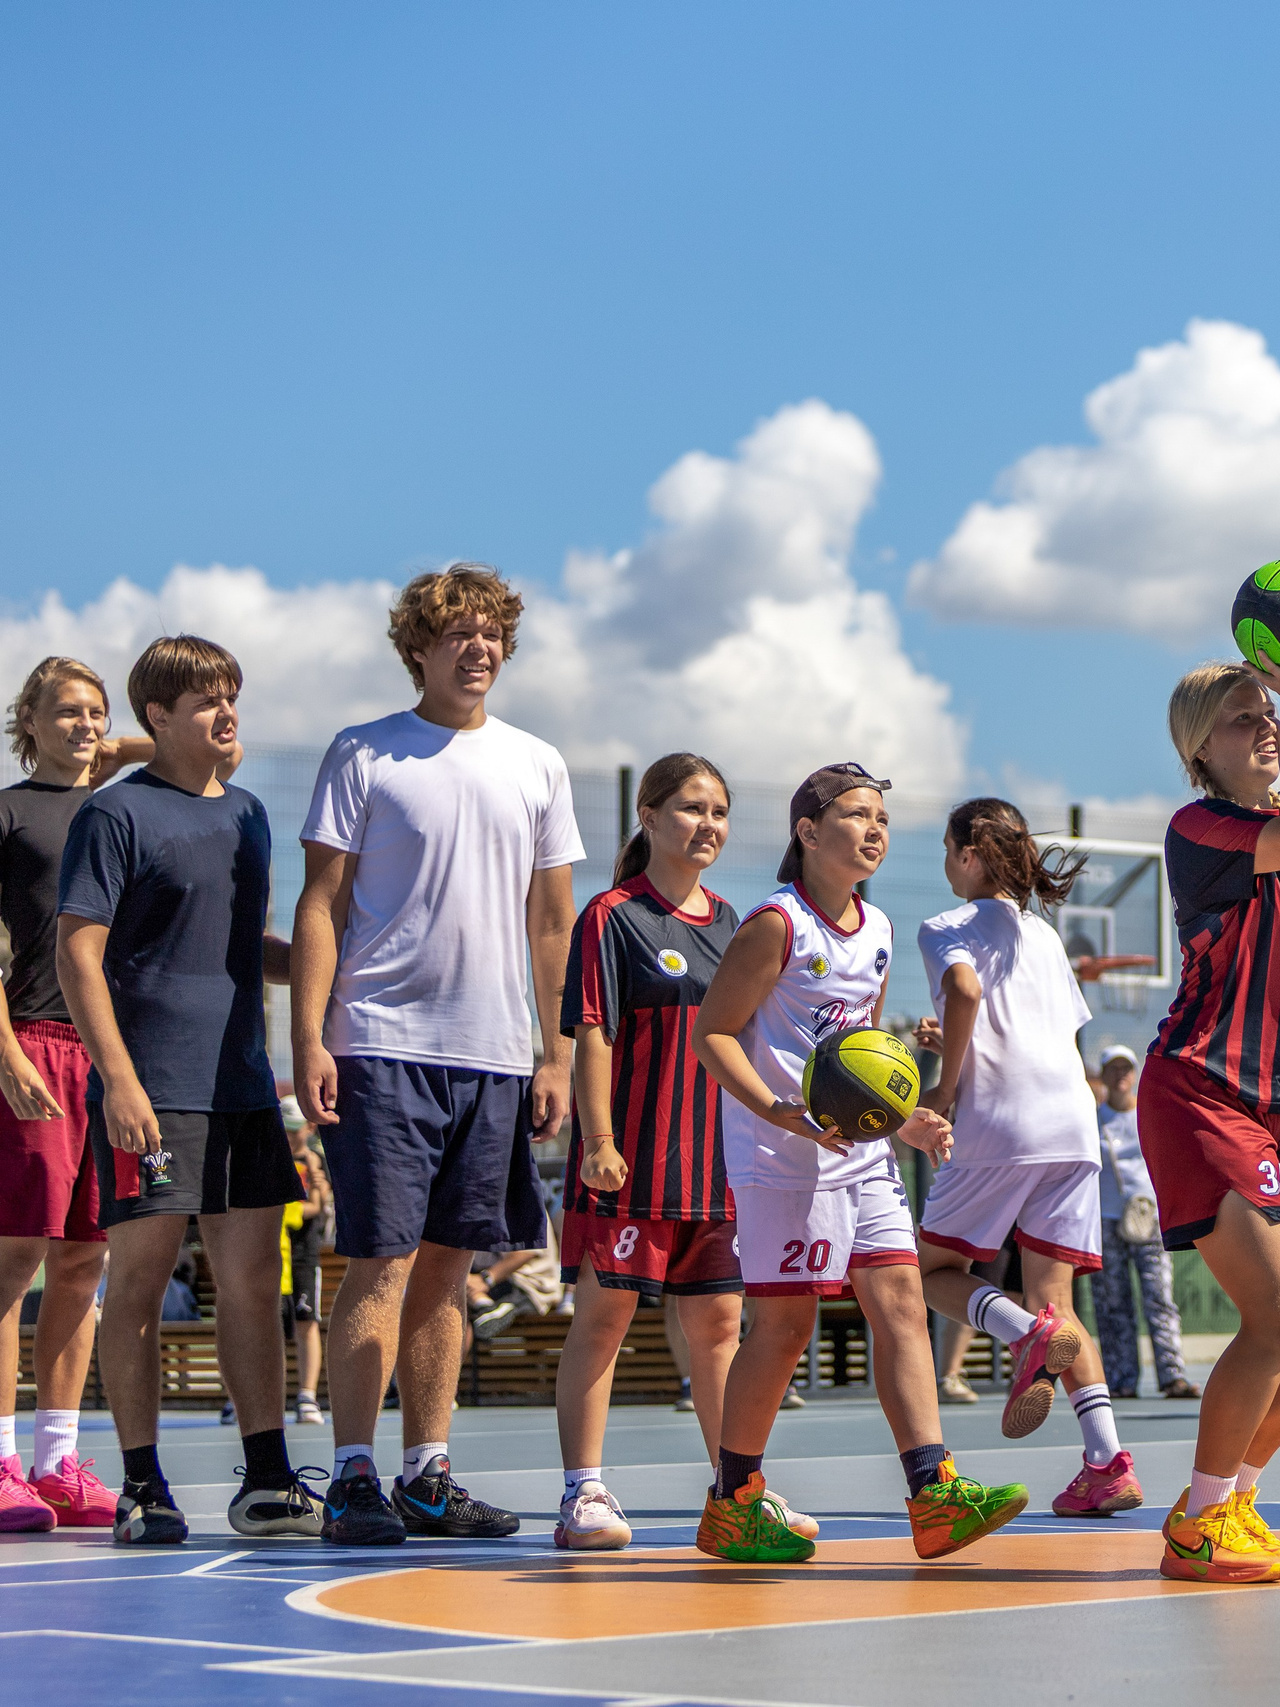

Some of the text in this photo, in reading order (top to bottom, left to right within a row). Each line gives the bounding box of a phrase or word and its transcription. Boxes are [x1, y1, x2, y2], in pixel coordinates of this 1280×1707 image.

[864, 1113, 882, 1129] РФБ
[613, 1225, 640, 1261] 8
[779, 1239, 833, 1275] 20
